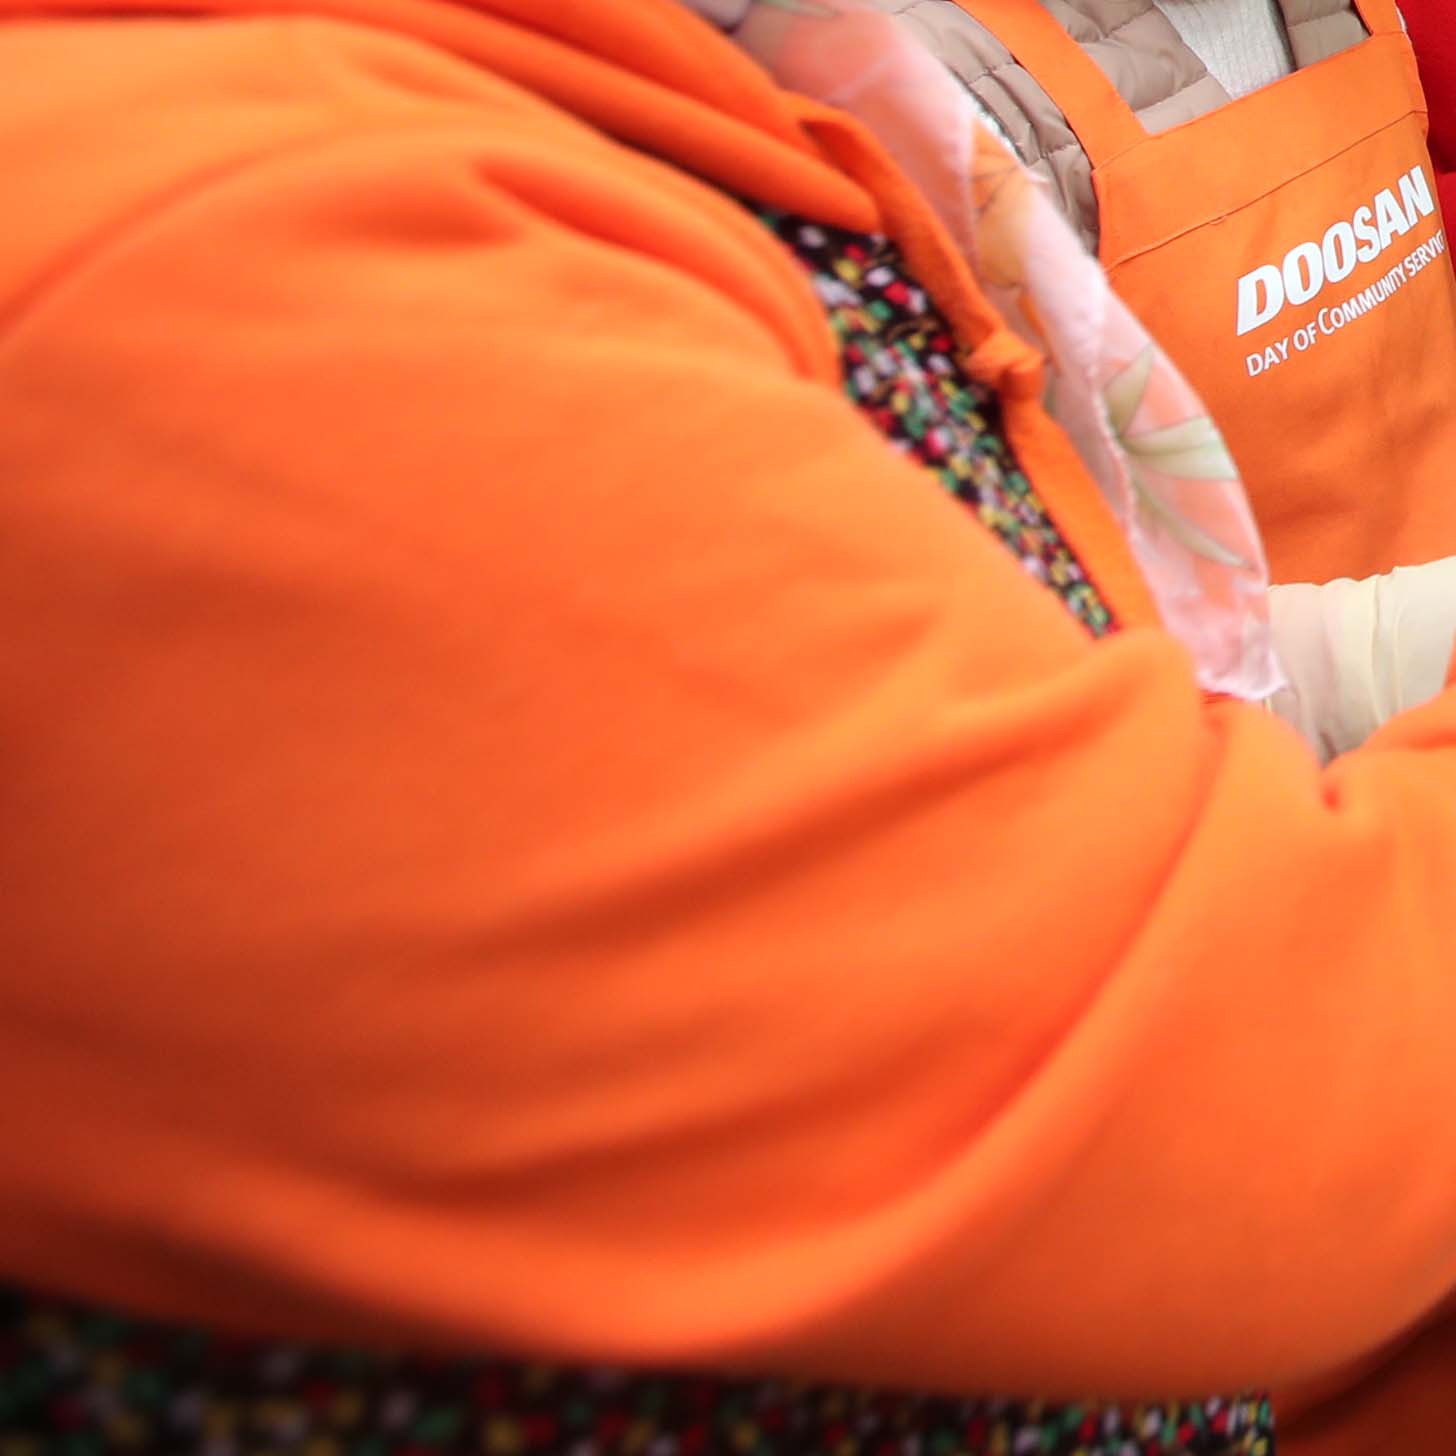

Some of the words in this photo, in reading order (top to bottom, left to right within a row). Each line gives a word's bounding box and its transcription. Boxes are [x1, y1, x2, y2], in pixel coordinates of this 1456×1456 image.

[1235, 165, 1435, 337] DOOSAN
[1246, 339, 1290, 376] DAY
[1292, 321, 1321, 352] OF
[1404, 229, 1445, 277] SERVIC
